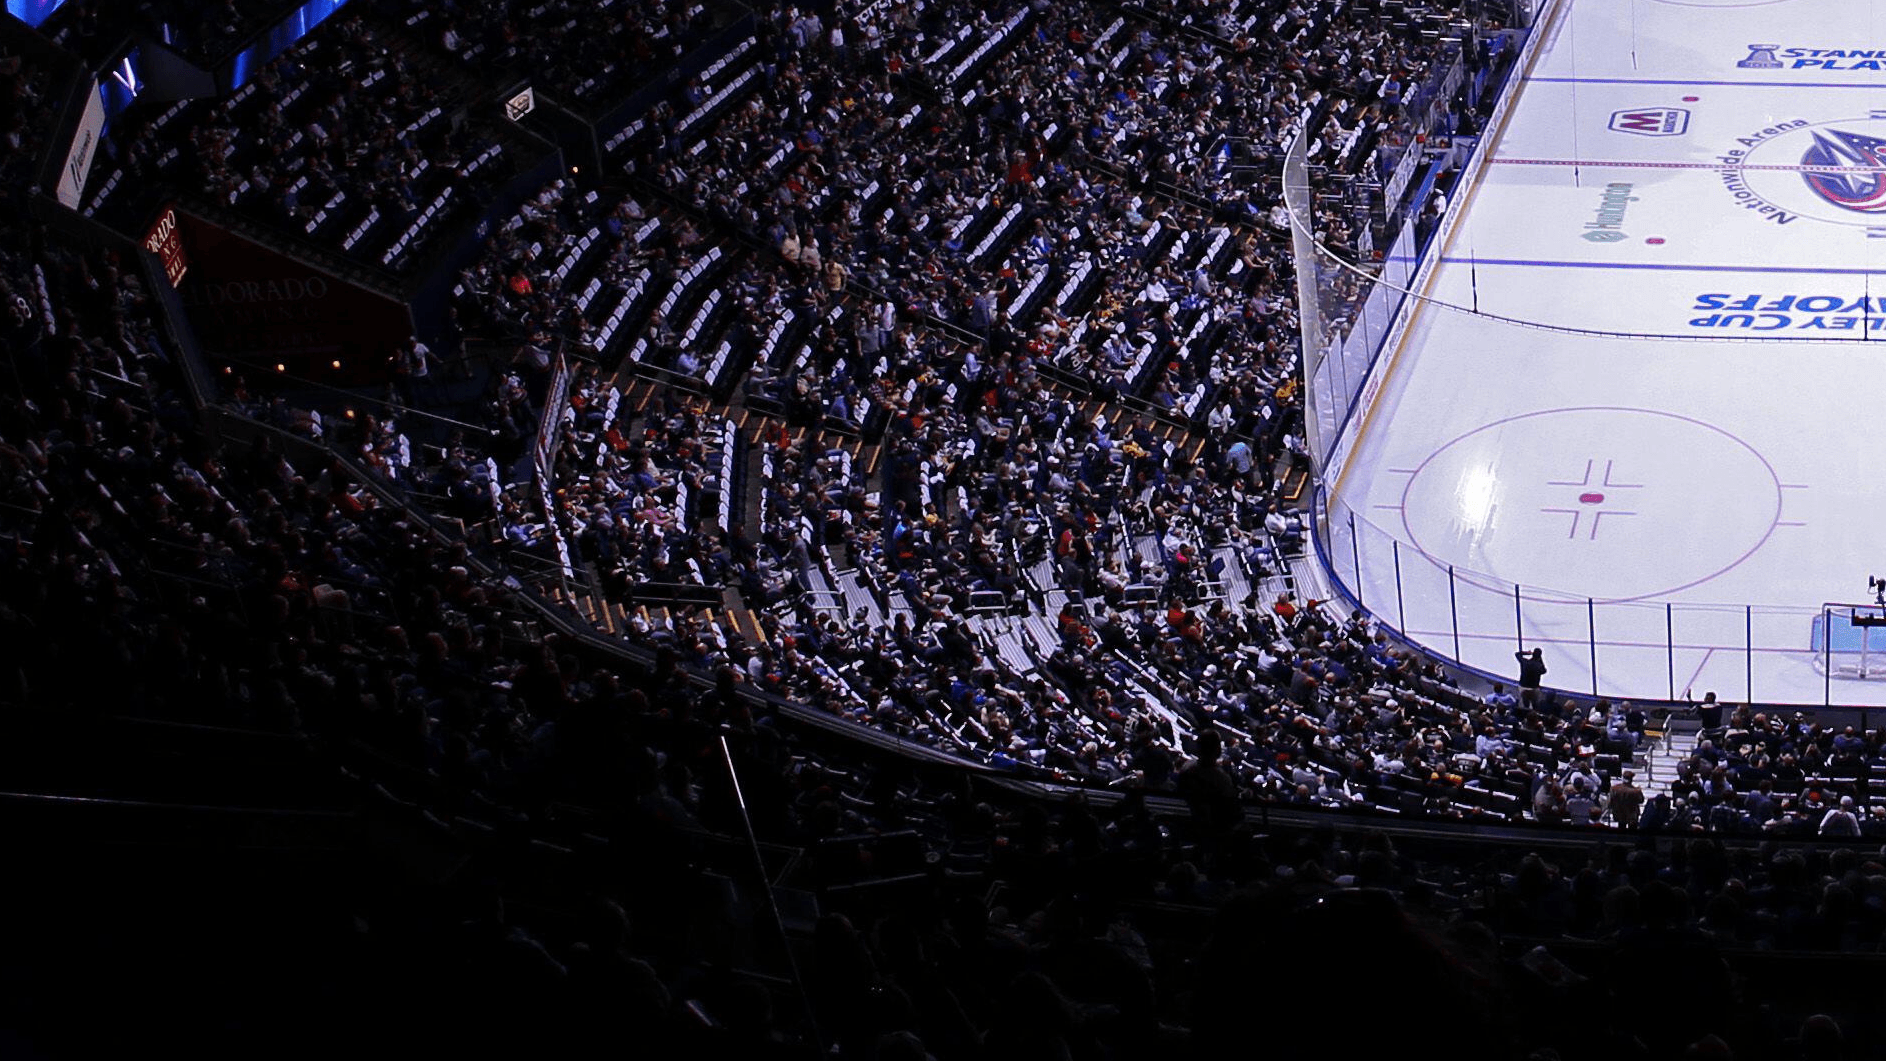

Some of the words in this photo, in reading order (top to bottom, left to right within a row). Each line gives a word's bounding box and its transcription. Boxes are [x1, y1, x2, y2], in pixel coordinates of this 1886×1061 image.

[1736, 119, 1809, 148] Arena
[1583, 182, 1641, 230] Huntington
[1714, 149, 1798, 225] Nationwide
[1688, 313, 1793, 332] CUP
